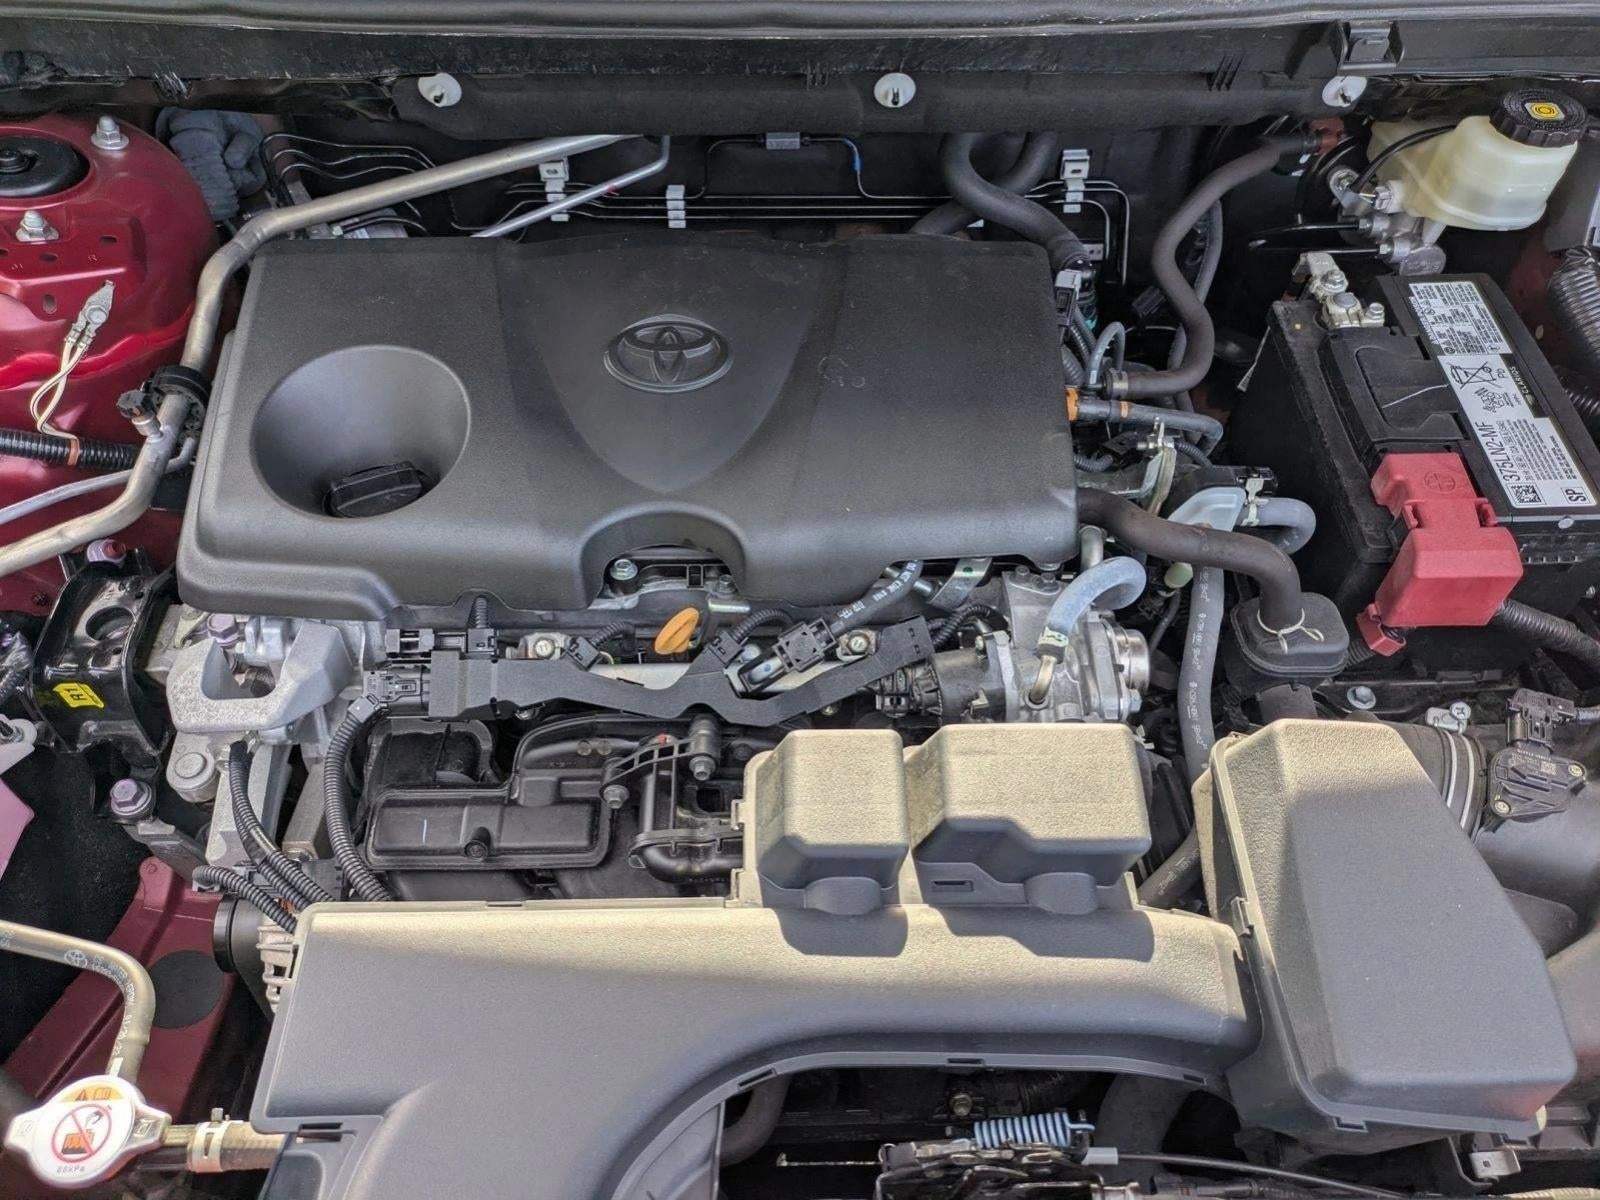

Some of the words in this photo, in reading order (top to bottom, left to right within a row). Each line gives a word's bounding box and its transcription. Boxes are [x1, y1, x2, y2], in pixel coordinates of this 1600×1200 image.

[1408, 295, 1425, 317] POISON
[1496, 368, 1508, 379] Pb
[1510, 366, 1529, 395] CLARIOS
[1474, 421, 1521, 482] 375LN2-MF
[1565, 488, 1587, 502] SP
